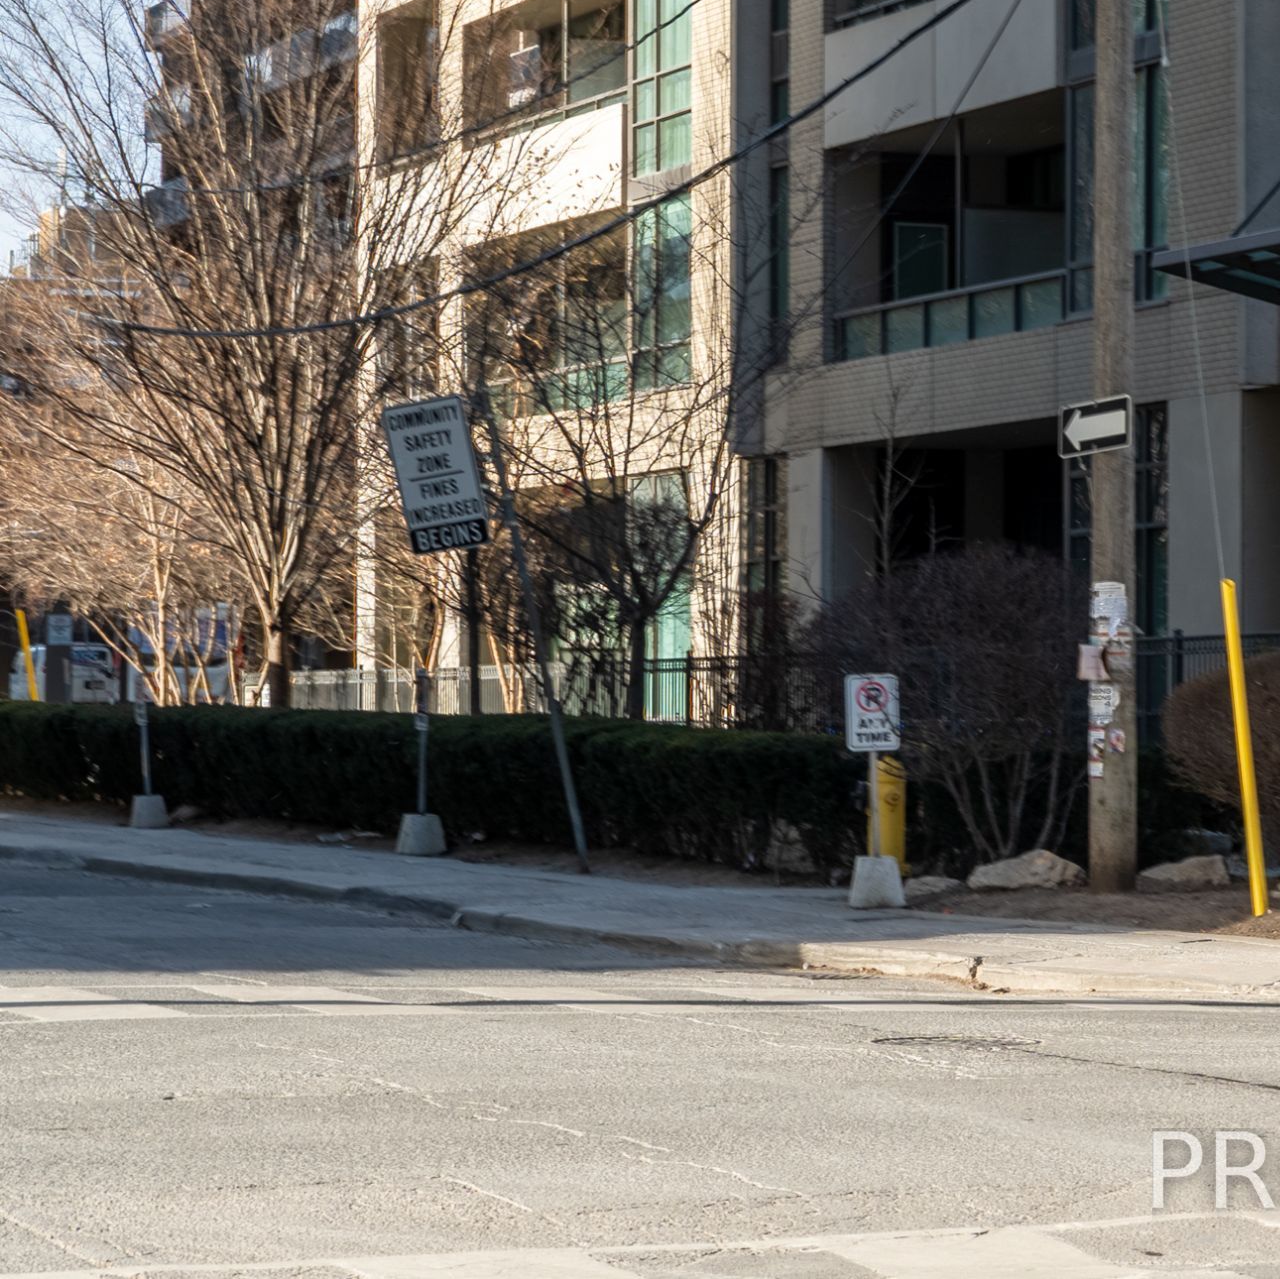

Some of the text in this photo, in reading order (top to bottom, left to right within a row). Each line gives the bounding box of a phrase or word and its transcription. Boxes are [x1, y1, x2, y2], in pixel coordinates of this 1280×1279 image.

[389, 405, 460, 432] COMMUNITY
[404, 430, 453, 452] SAFETY
[416, 453, 452, 474] ZONE
[420, 479, 460, 500] FINES
[409, 498, 481, 525] INCREASED
[415, 522, 483, 551] BEGINS
[855, 731, 893, 744] TIME
